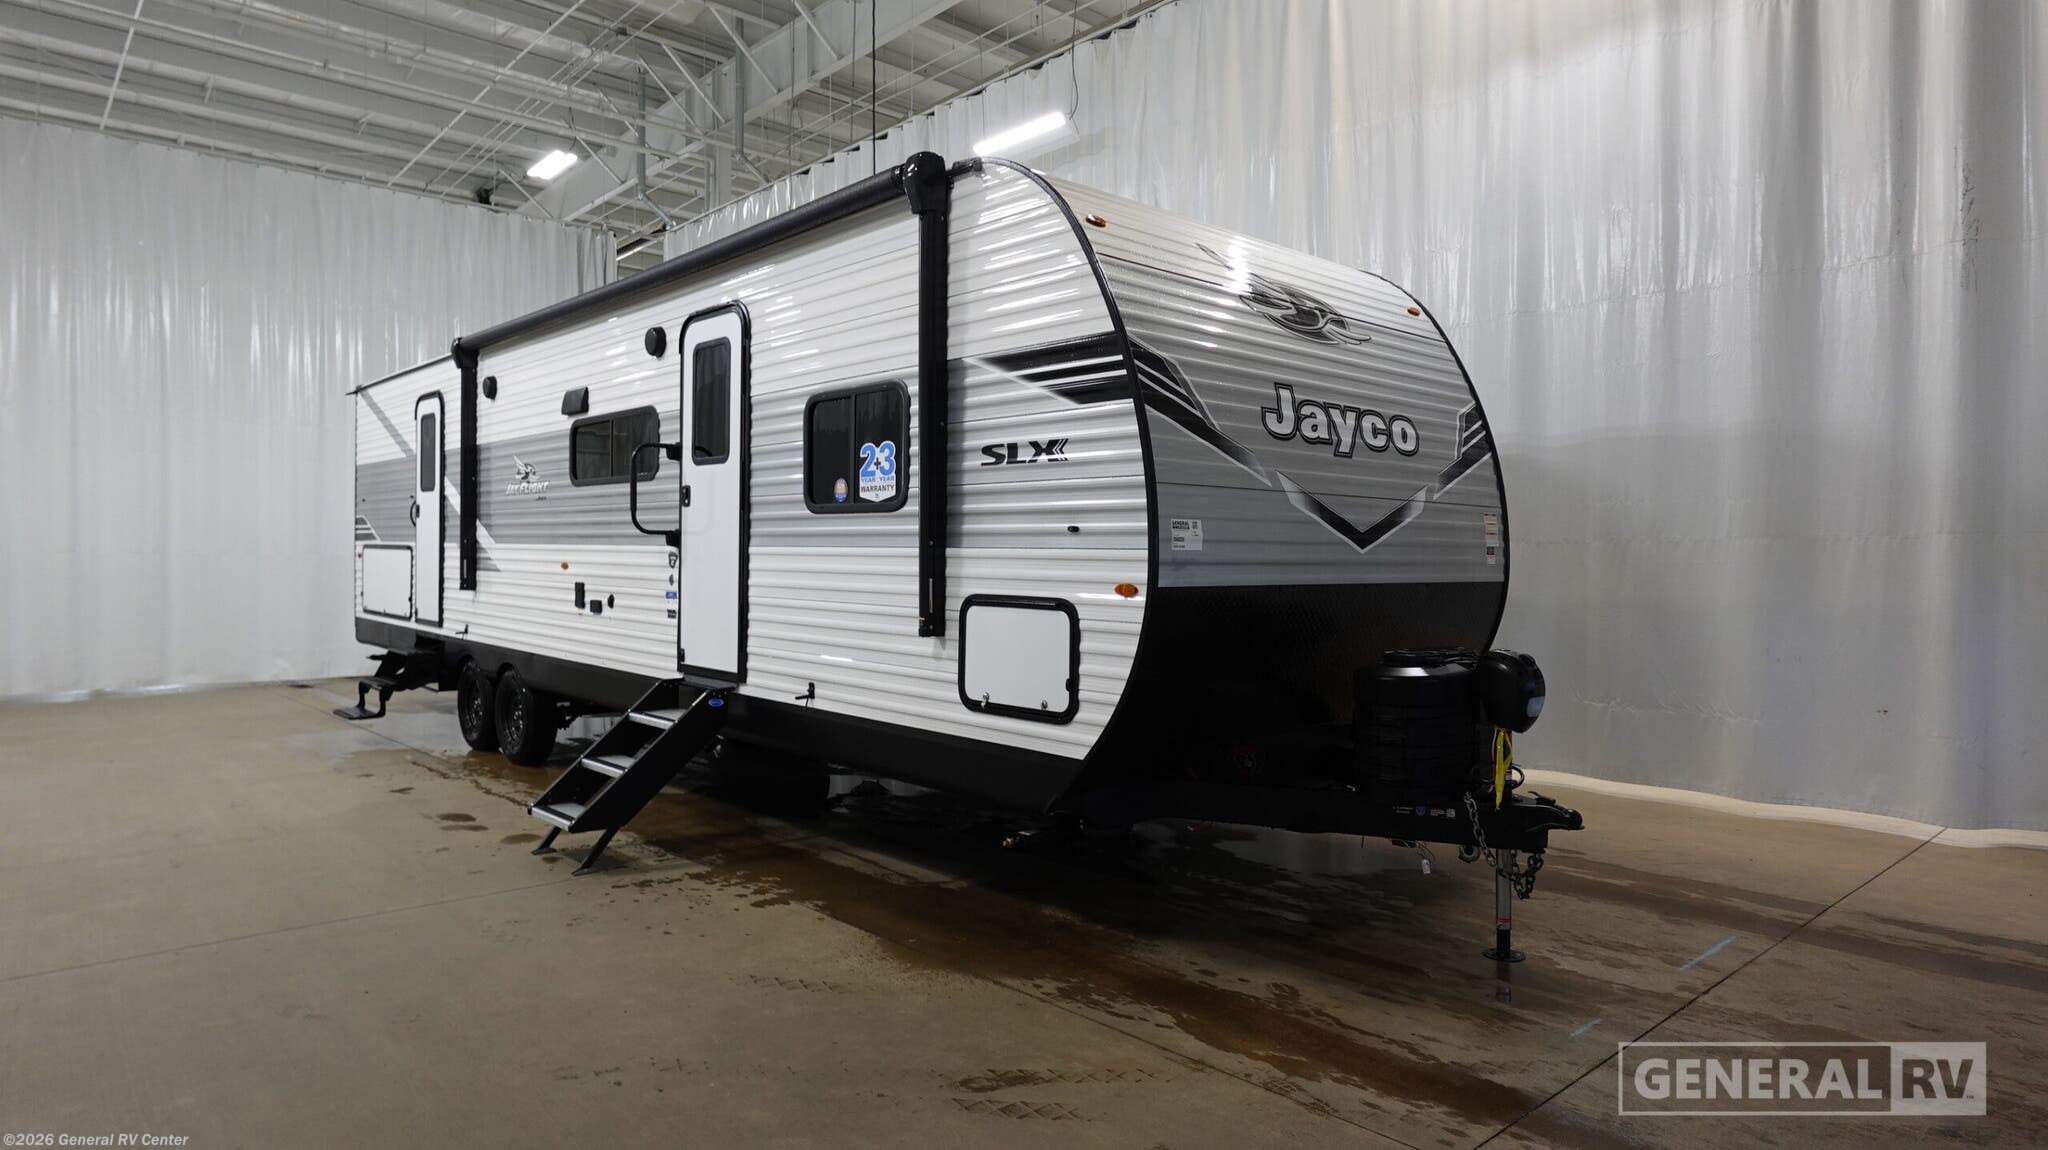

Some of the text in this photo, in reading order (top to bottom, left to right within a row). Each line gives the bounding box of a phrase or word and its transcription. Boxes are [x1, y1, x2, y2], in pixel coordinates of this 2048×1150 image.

[1261, 382, 1420, 458] Jayco
[980, 438, 1068, 466] SLX
[860, 484, 895, 493] WARRANTY
